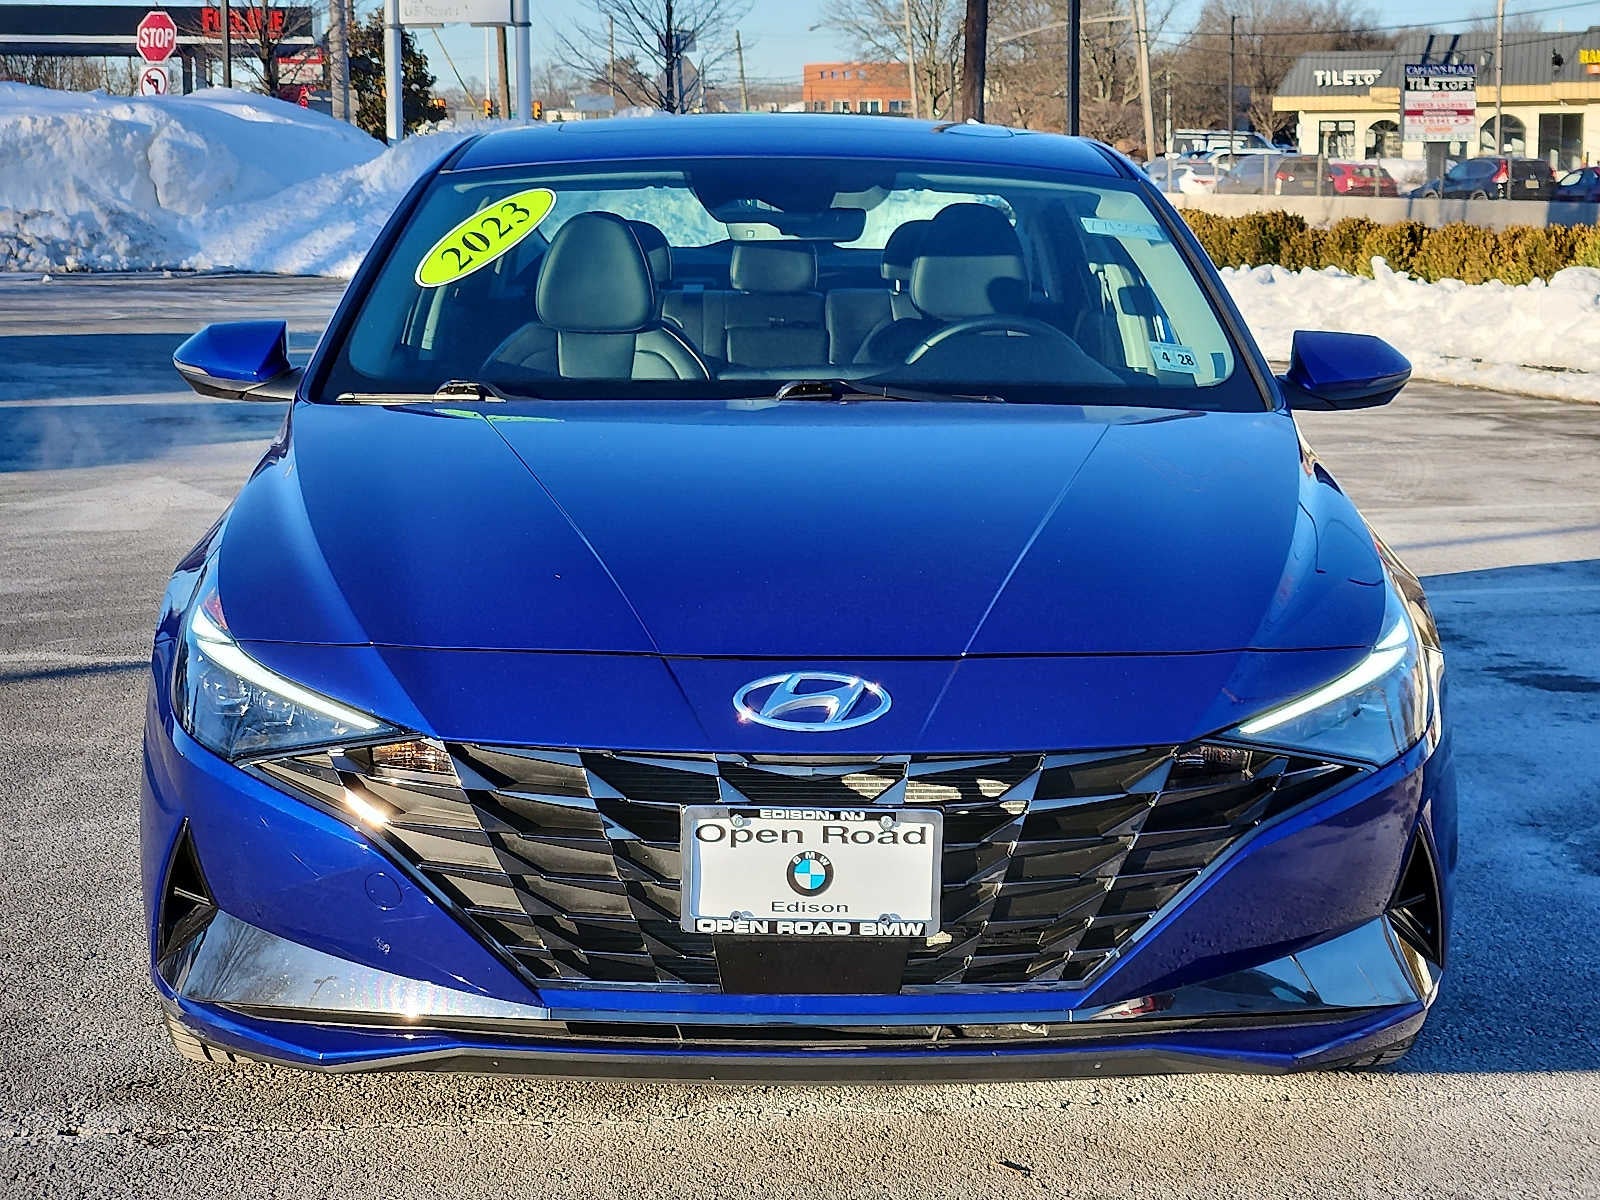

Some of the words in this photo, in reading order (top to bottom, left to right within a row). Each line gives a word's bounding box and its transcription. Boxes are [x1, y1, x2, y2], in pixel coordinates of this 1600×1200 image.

[140, 27, 174, 48] STOP
[441, 203, 530, 271] 2023
[1162, 351, 1170, 363] 4
[1177, 353, 1195, 366] 28
[841, 811, 865, 821] NJ
[695, 824, 804, 848] Open
[822, 825, 926, 844] Road
[793, 851, 830, 866] BMW
[771, 901, 849, 913] Edison
[696, 919, 769, 934] OPEN
[777, 920, 852, 935] ROAD
[860, 921, 924, 936] BMW
